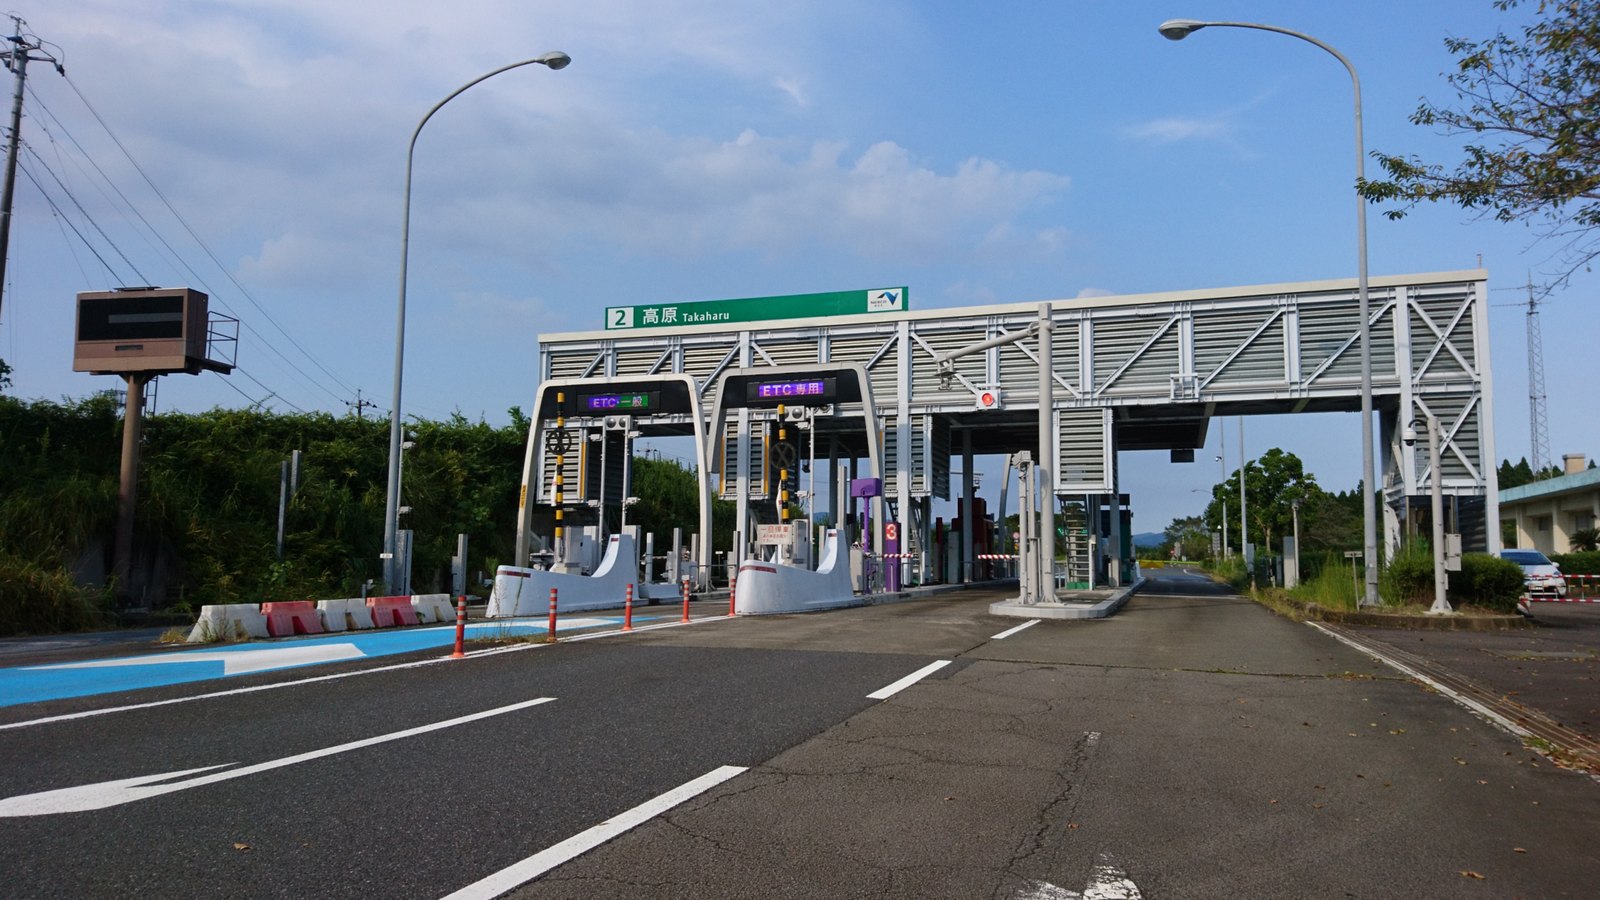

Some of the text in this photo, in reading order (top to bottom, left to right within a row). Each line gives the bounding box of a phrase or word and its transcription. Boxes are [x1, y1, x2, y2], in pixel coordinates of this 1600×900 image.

[614, 309, 626, 326] 2
[643, 307, 678, 325] 高原
[682, 311, 730, 322] Takaharu
[763, 382, 819, 397] ETC 専用
[886, 523, 897, 540] 3
